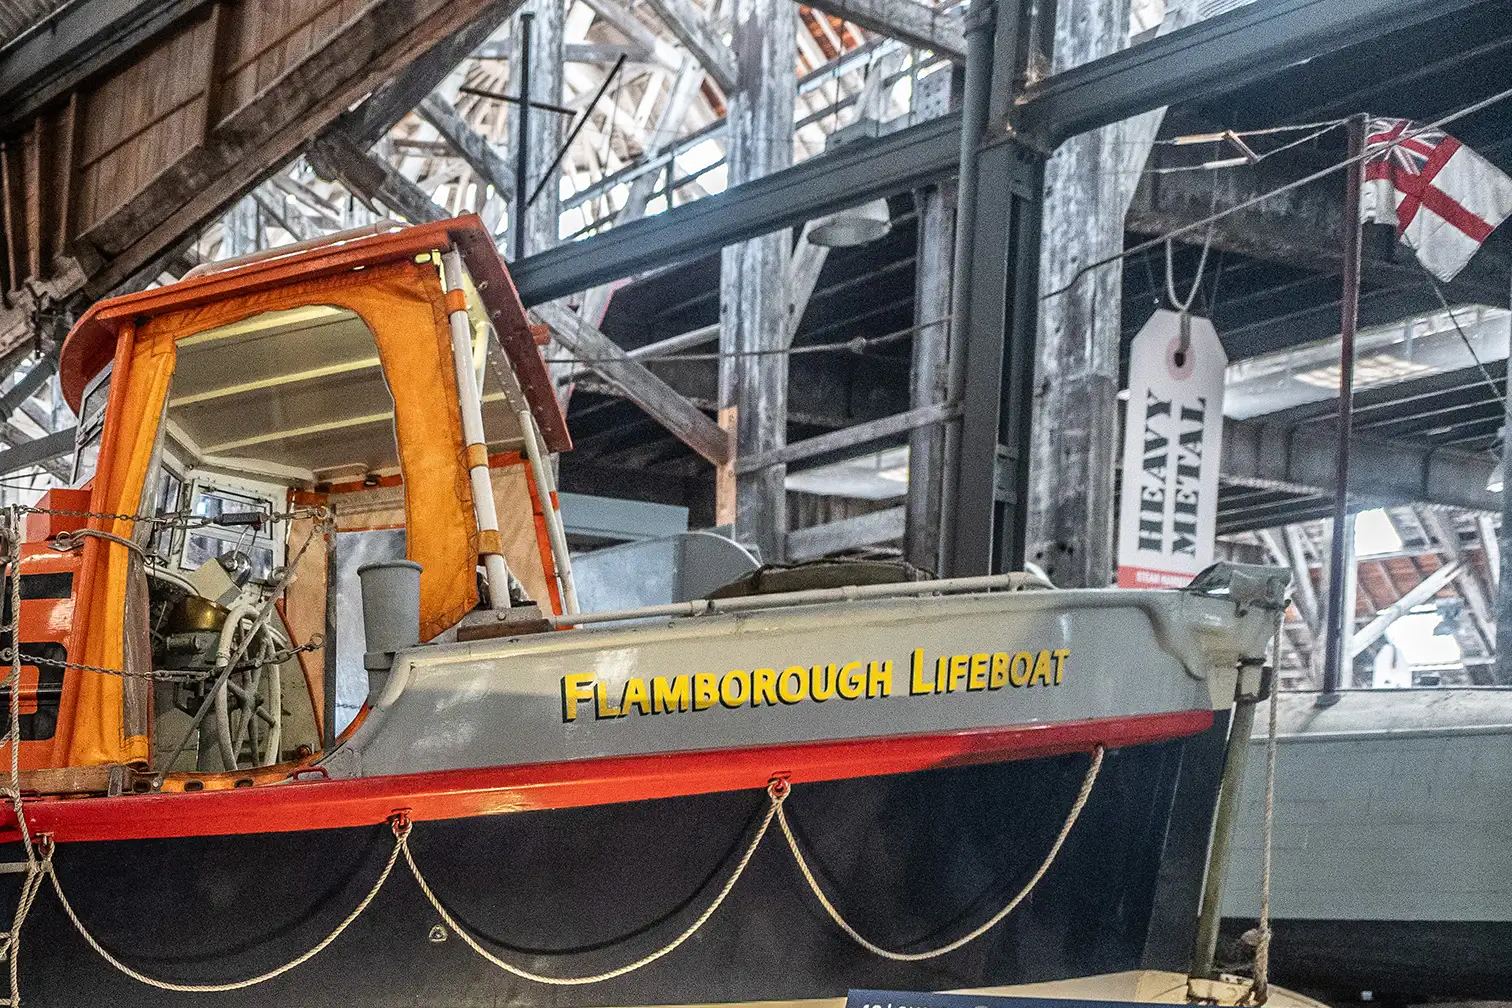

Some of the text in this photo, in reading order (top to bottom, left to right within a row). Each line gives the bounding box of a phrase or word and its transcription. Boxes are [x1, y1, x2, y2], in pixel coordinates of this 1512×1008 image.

[1138, 388, 1172, 551] HEAVY
[1172, 397, 1206, 557] METAL
[560, 647, 1070, 723] FLAMBOROUGH LIFEBOAT
